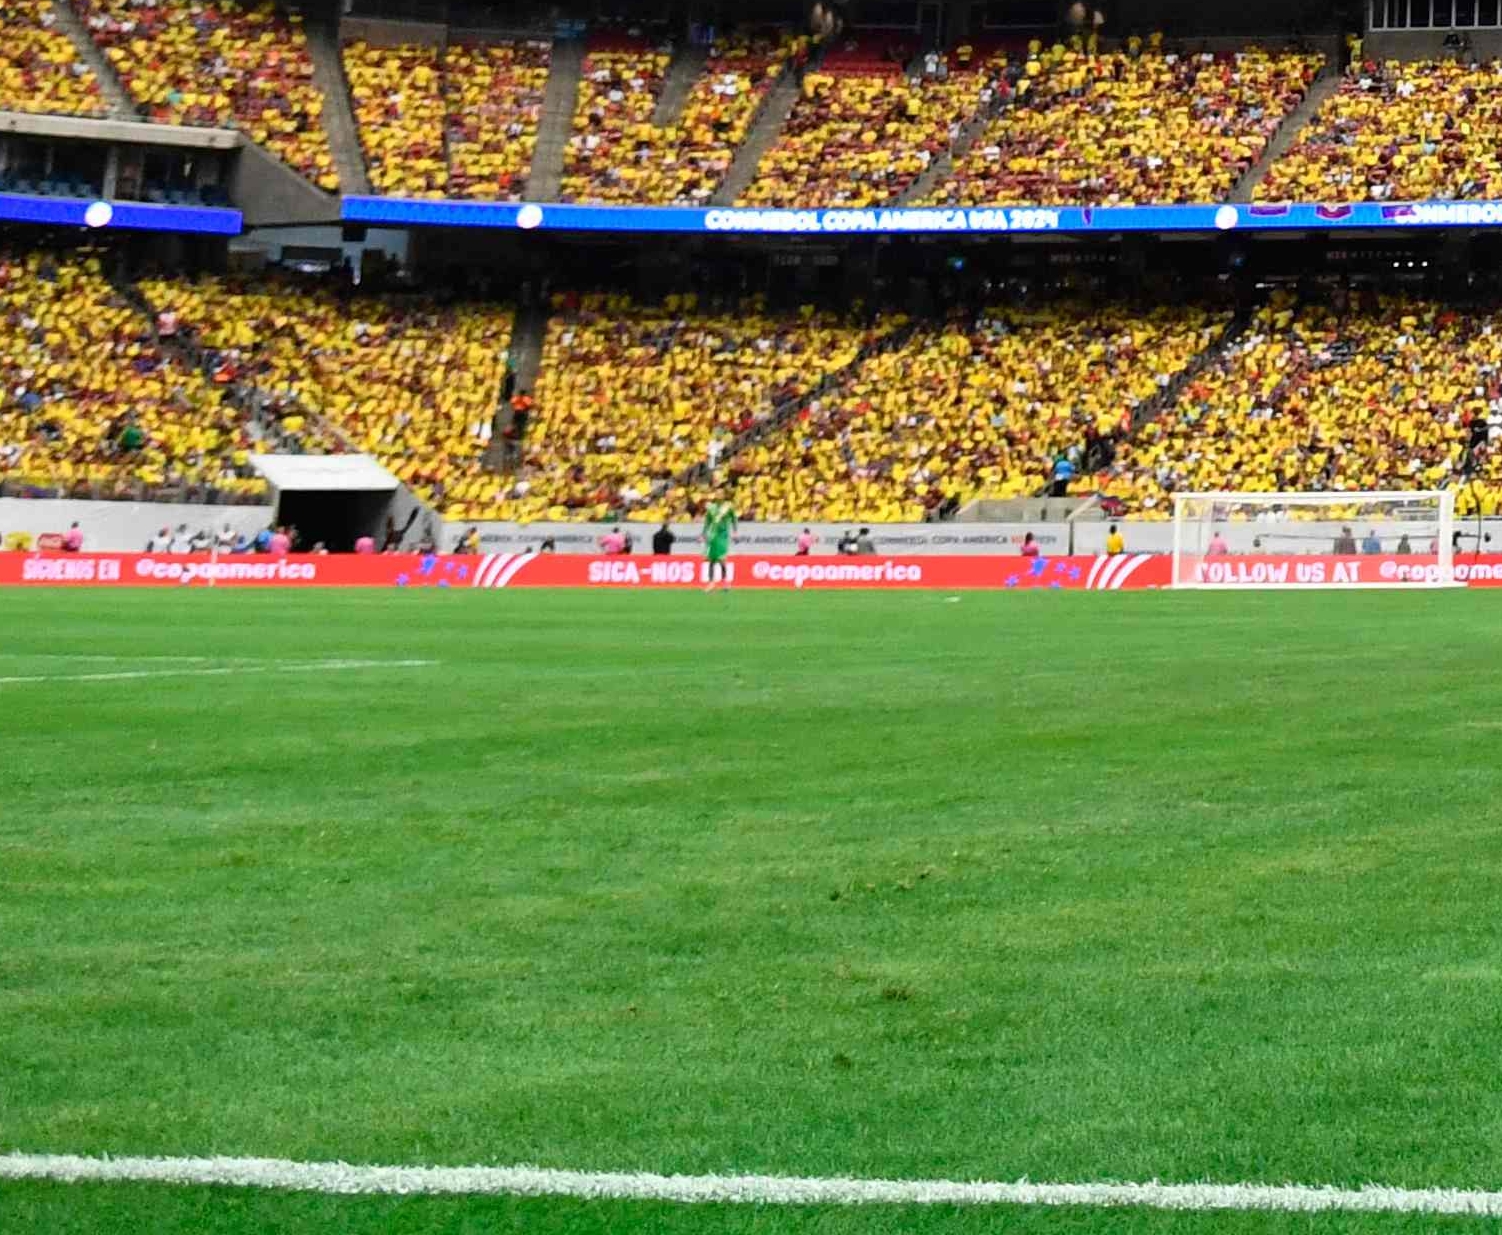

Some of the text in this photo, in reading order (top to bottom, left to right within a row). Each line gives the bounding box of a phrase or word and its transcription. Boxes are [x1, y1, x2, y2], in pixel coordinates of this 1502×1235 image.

[704, 210, 821, 231] CONMEBOL
[822, 210, 878, 230] COPA
[877, 210, 967, 230] AMERICA
[752, 559, 922, 588] @copaamerica
[1300, 560, 1325, 582] US
[1332, 560, 1361, 582] AT
